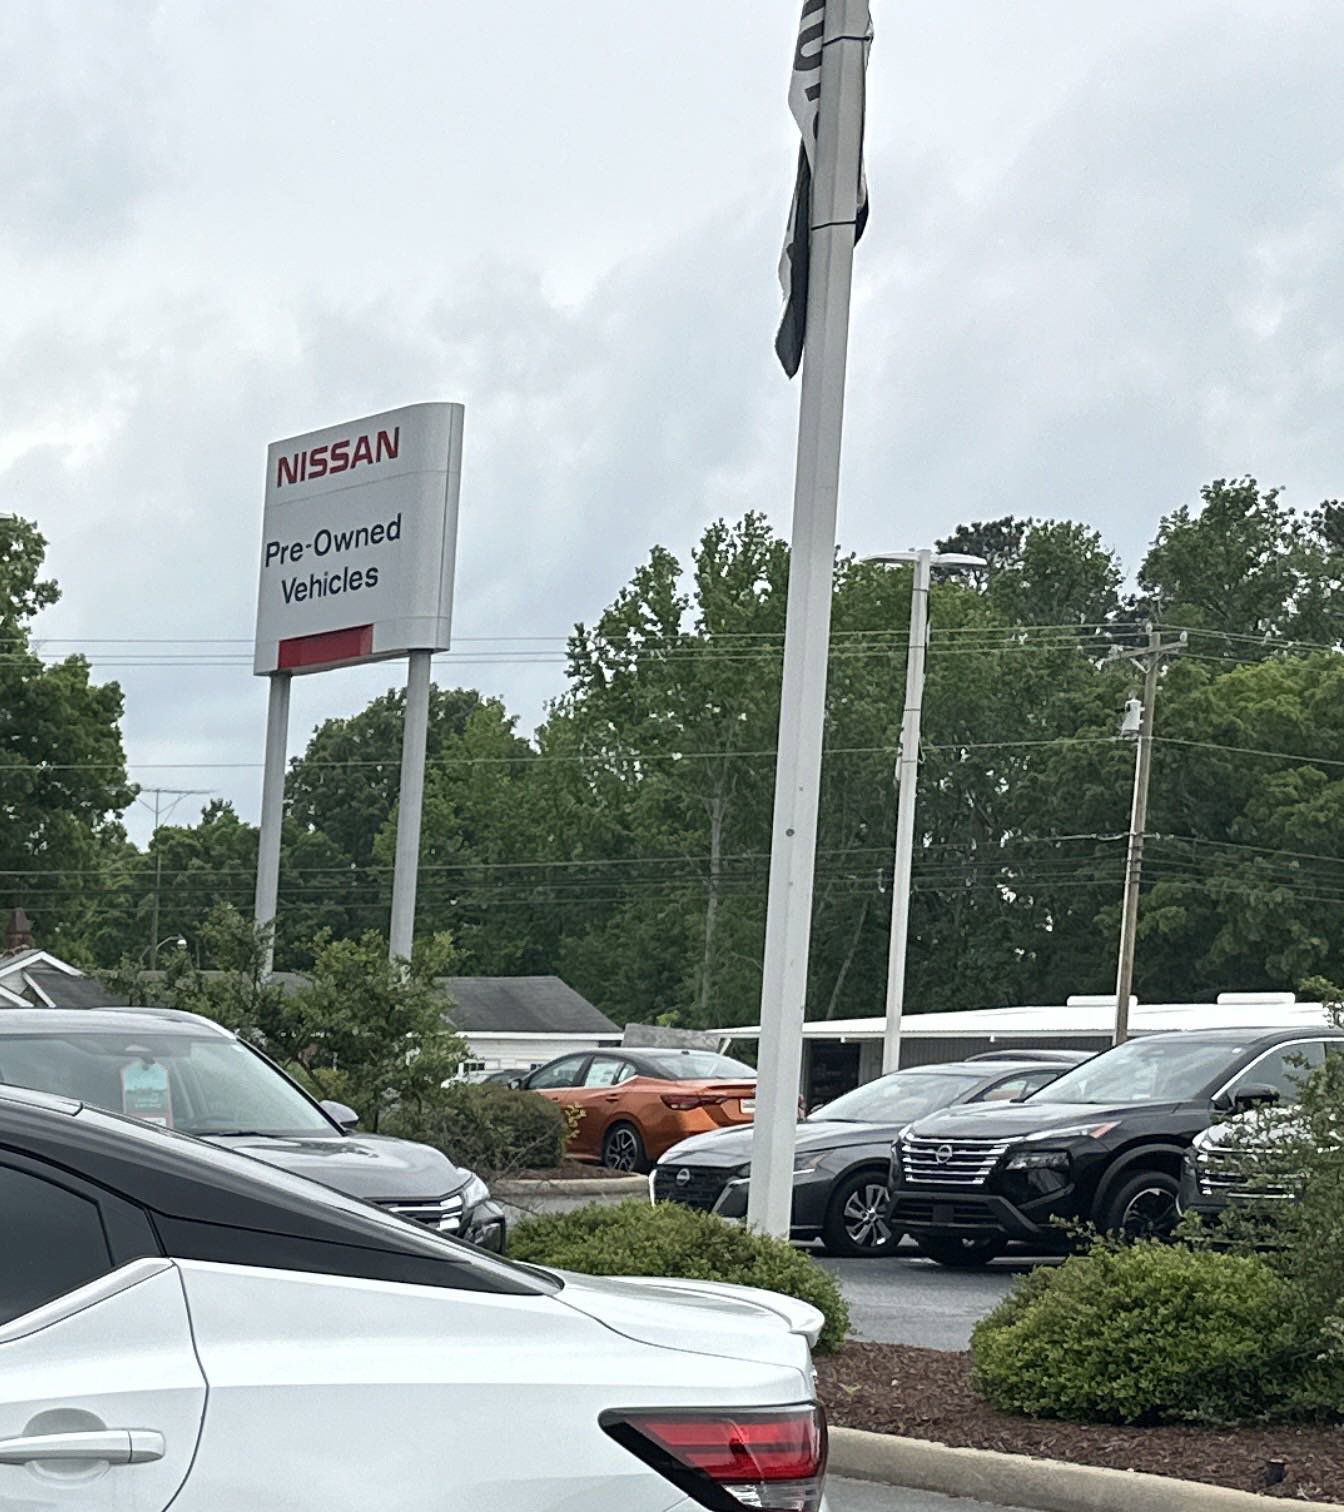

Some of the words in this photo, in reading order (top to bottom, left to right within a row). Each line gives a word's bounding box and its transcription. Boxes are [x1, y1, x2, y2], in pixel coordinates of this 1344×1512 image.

[276, 426, 400, 488] NISSAN
[264, 512, 402, 568] Pre-Owned
[280, 566, 379, 604] Vehicles
